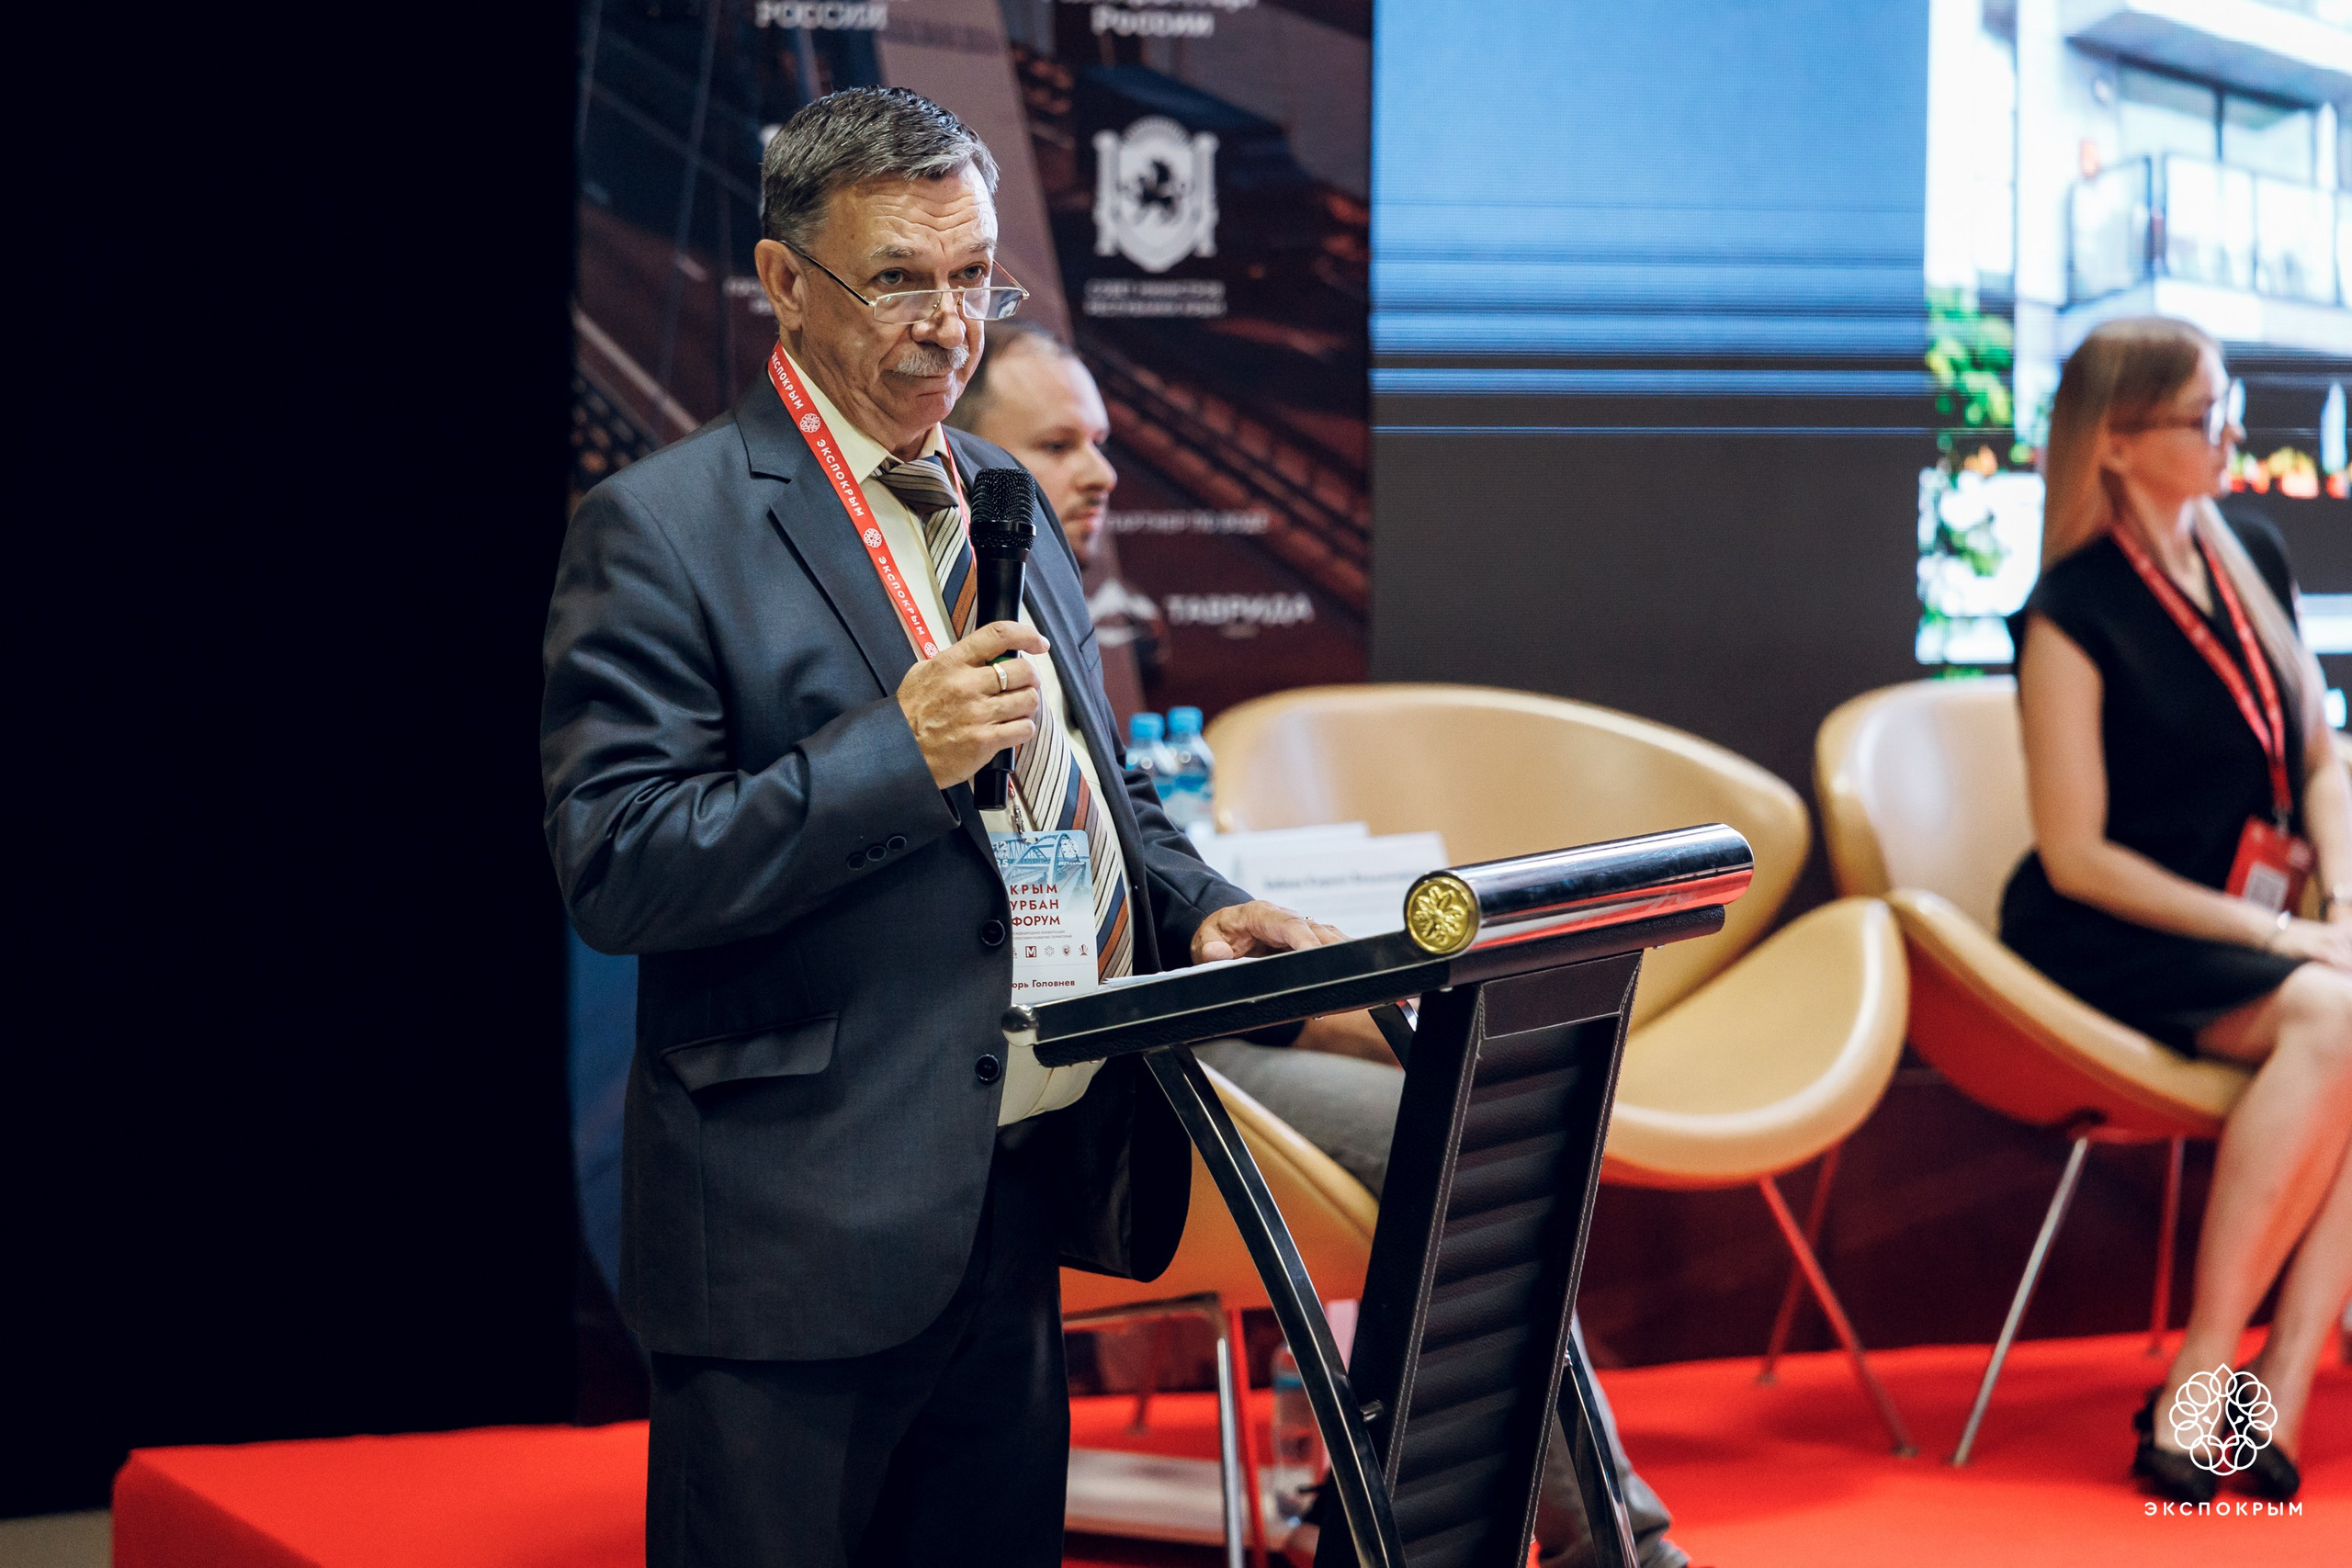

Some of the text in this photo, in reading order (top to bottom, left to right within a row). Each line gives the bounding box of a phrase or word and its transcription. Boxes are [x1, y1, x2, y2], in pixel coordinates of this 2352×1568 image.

[817, 439, 865, 517] ЭКСПОКРЫМ
[878, 556, 925, 636] ЭКСПОКРЫМ
[1010, 884, 1057, 896] КРЫМ
[1010, 899, 1059, 911] УРБАН
[1012, 915, 1060, 927] ФОРУМ
[1012, 979, 1076, 990] орь Головнев
